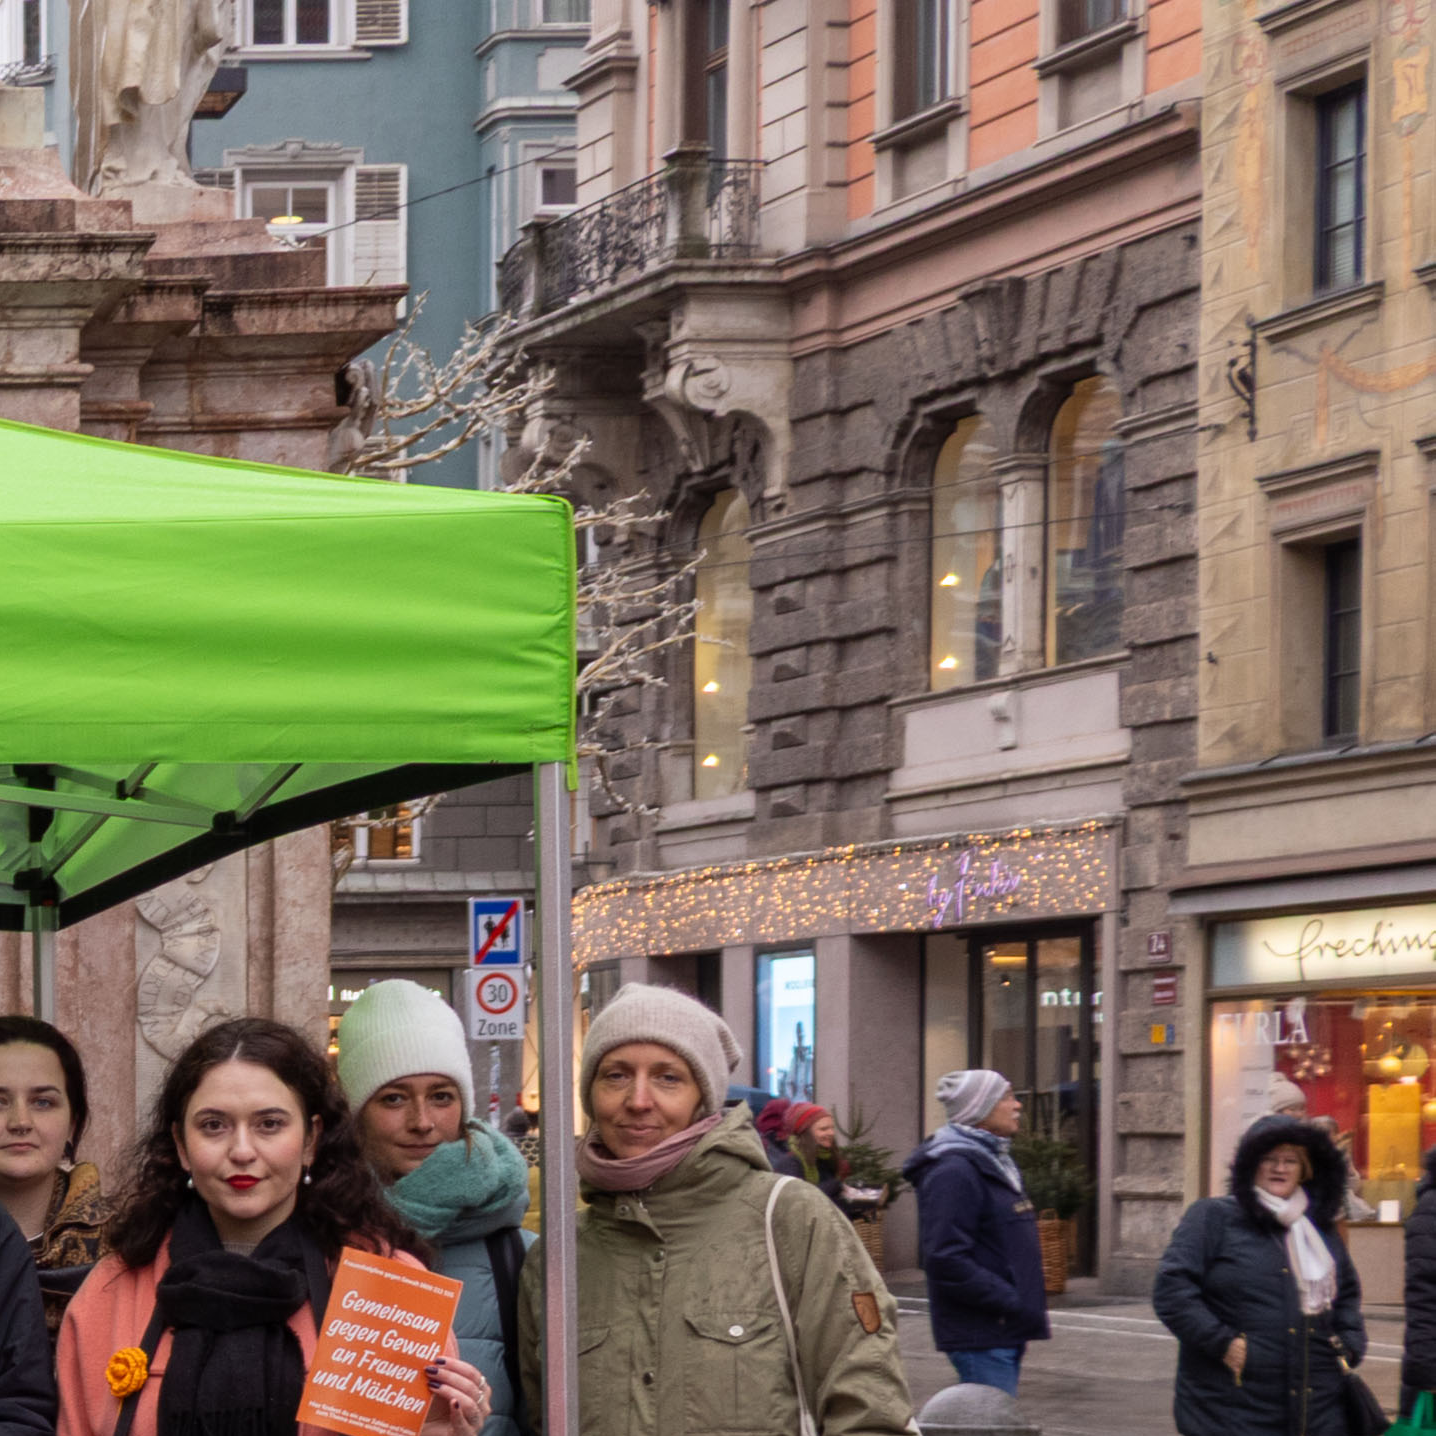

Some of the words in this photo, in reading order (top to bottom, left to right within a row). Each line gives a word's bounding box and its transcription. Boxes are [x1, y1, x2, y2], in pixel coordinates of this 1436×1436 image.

[487, 983, 508, 1004] 30
[478, 1019, 517, 1036] Zone
[1217, 1009, 1310, 1046] FURLA
[341, 1290, 440, 1334] Gemeinsam
[326, 1319, 379, 1343] gegen
[381, 1329, 439, 1360] Gewalt
[331, 1347, 356, 1364] an
[357, 1349, 418, 1382] Frauen
[312, 1370, 352, 1390] und
[350, 1375, 425, 1413] Mädchen
